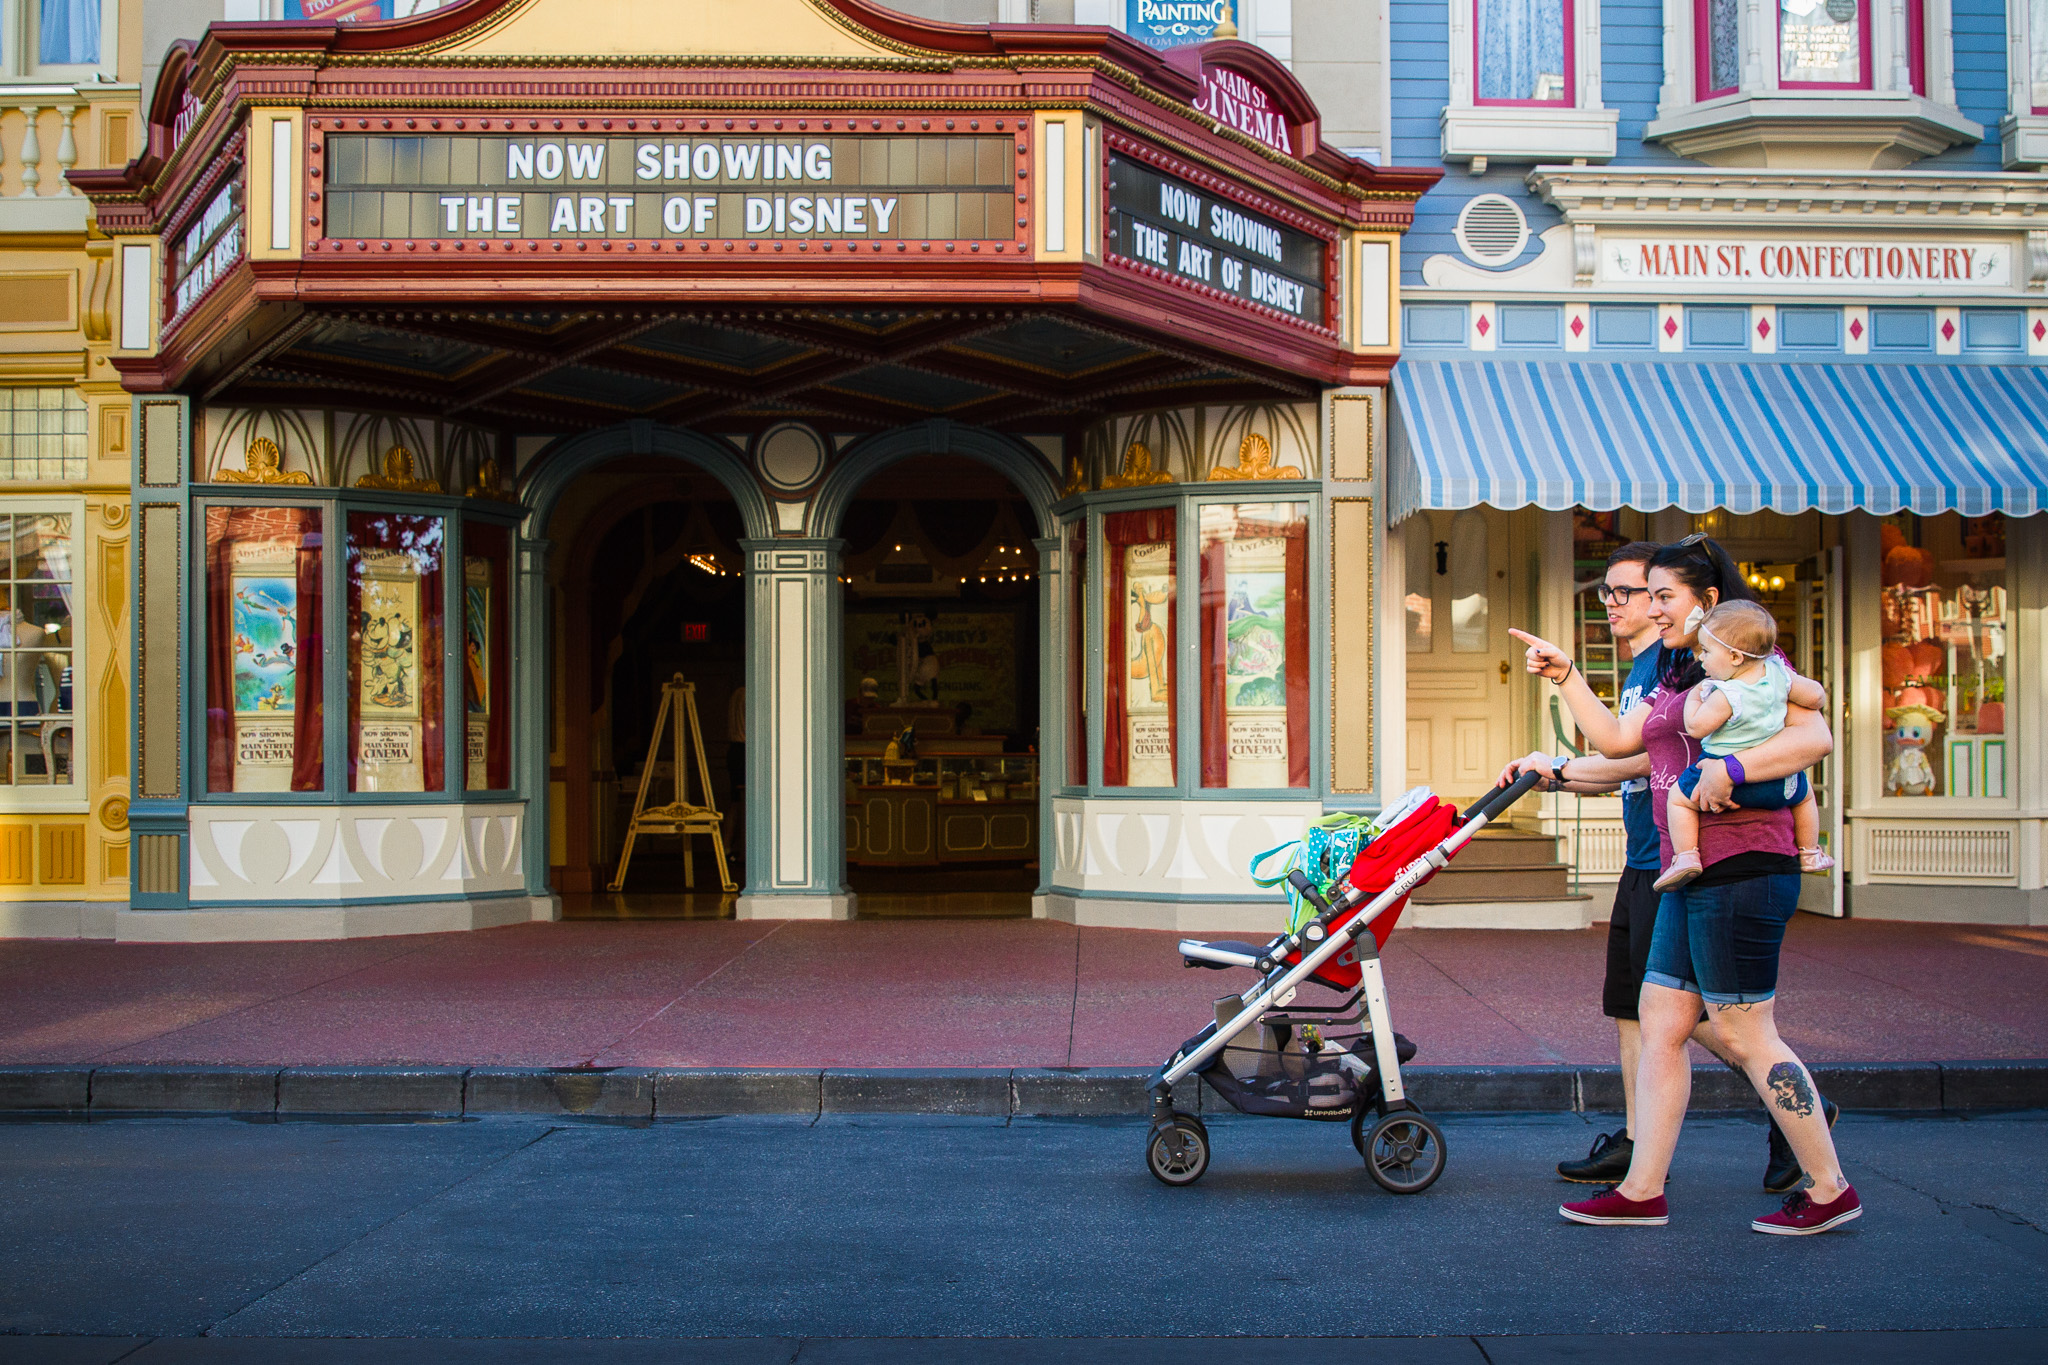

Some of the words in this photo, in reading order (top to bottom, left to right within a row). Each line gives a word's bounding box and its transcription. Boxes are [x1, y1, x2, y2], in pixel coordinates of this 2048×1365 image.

[1138, 0, 1226, 24] PAINTING
[1215, 68, 1251, 104] MAIN
[1252, 86, 1269, 110] ST.
[508, 143, 605, 180] NOW
[636, 143, 832, 180] SHOWING
[440, 197, 521, 233] THE
[550, 197, 634, 233] ART
[663, 197, 718, 234] OF
[746, 197, 898, 234] DISNEY
[1161, 183, 1200, 229] NOW
[1210, 204, 1282, 262] SHOWING
[1133, 222, 1168, 266] THE
[1178, 241, 1212, 281] ART
[1221, 257, 1243, 292] OF
[1251, 268, 1304, 314] DISNEY
[1638, 244, 1710, 277] MAIN
[1717, 244, 1752, 277] ST.
[1760, 245, 1977, 280] CONFECTIONERY
[686, 624, 707, 640] EXIT
[240, 750, 294, 760] CINEMA
[364, 749, 409, 758] CINEMA
[1135, 745, 1170, 754] CINEMA
[1232, 745, 1282, 754] CINEMA
[1395, 872, 1421, 896] CRUZ
